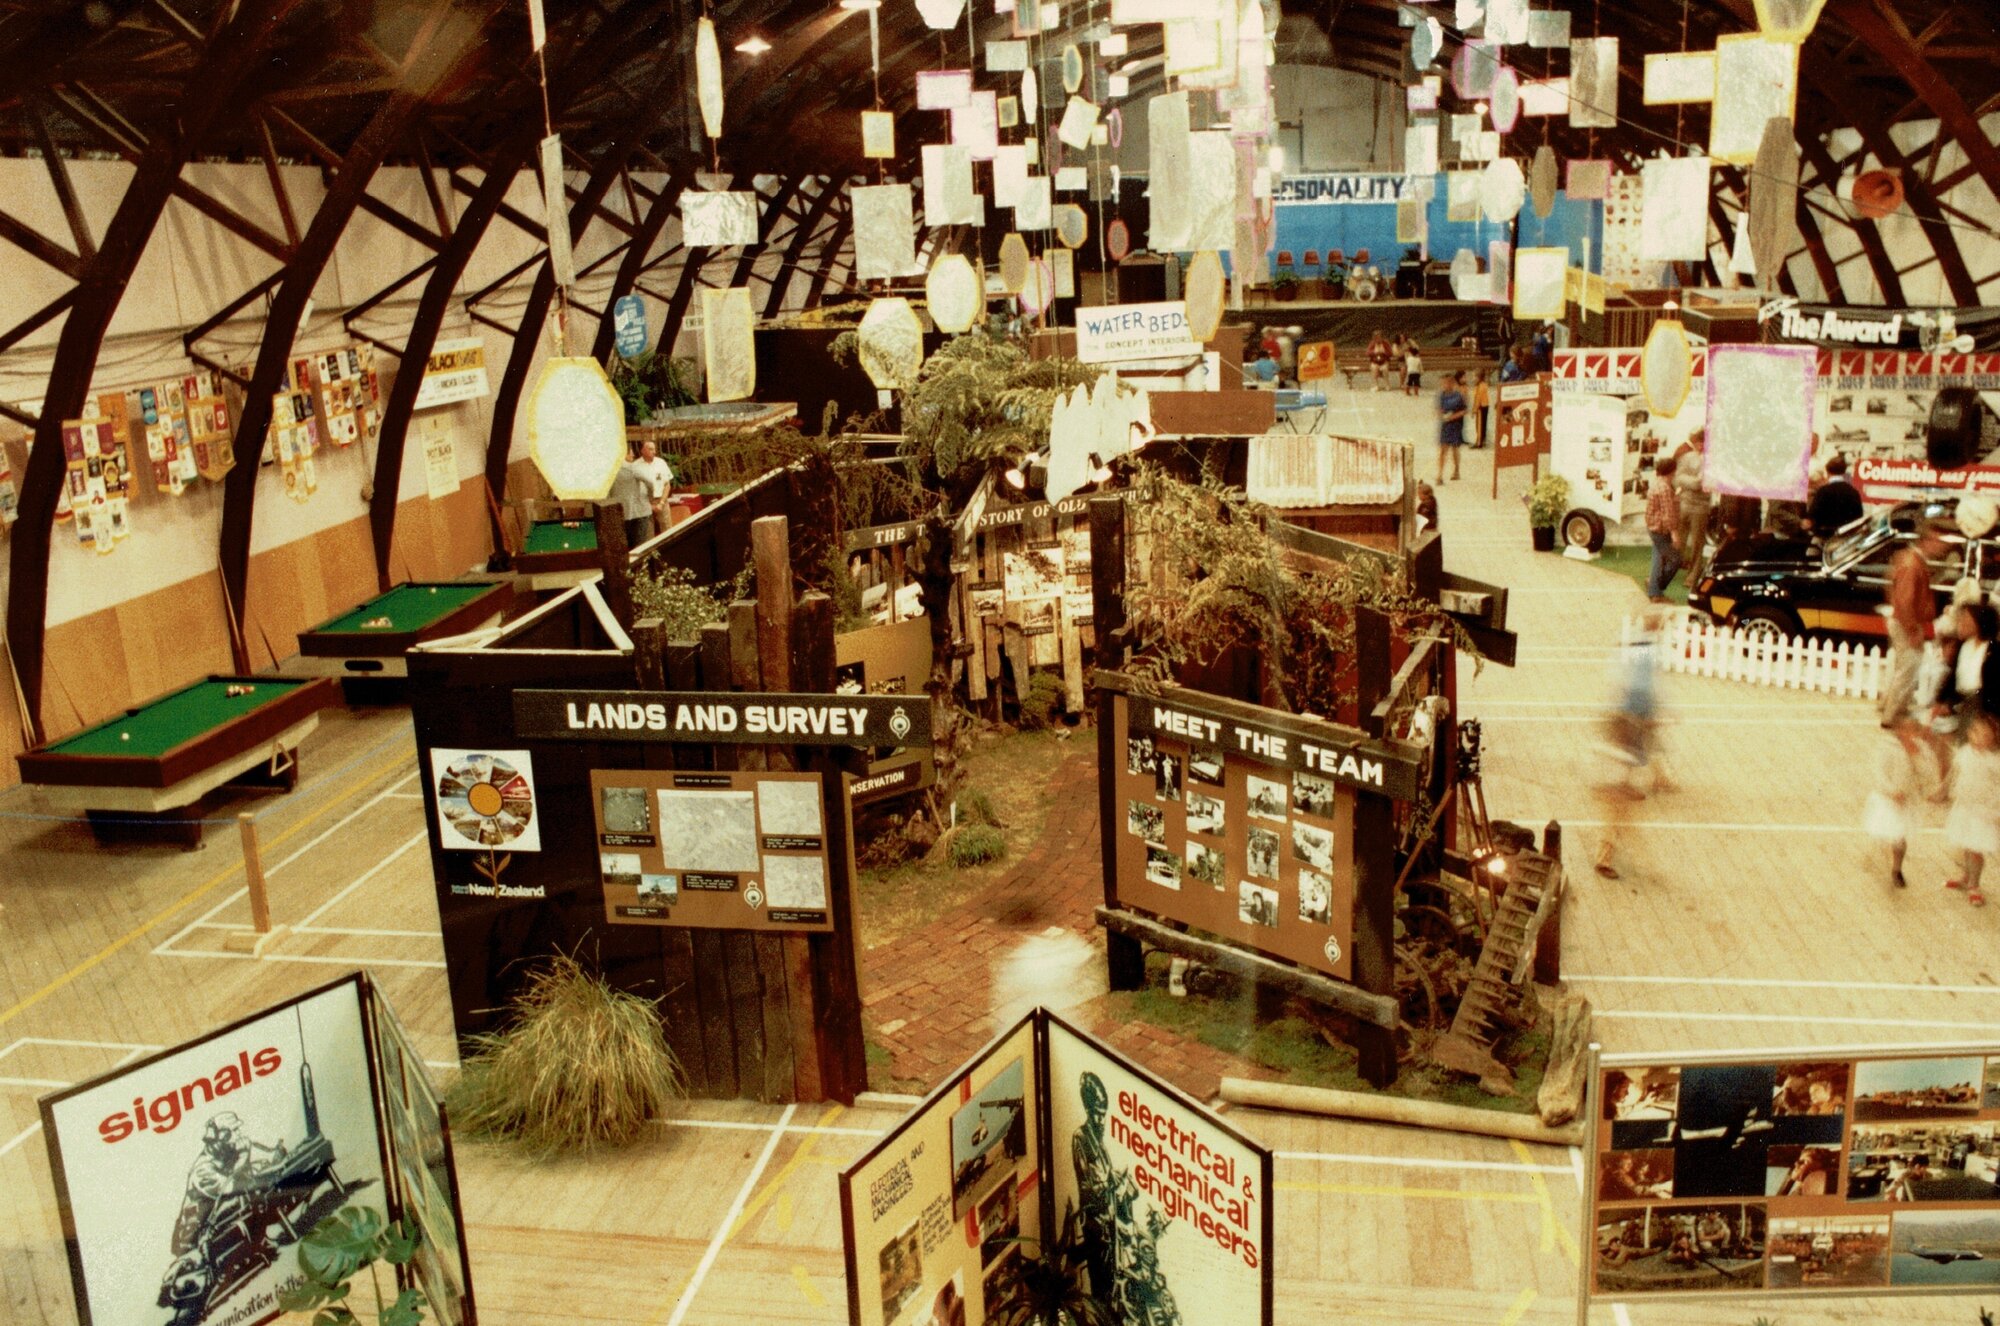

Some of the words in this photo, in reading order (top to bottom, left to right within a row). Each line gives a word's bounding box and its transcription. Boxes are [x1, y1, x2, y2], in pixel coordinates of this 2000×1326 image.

[1271, 177, 1405, 200] RSONALITY
[1086, 312, 1145, 335] WATER
[1781, 308, 1820, 339] The
[1821, 310, 1902, 344] Award
[1105, 339, 1143, 349] CONCEPT
[1858, 460, 1938, 484] Columbia
[874, 527, 906, 544] THE
[980, 507, 1024, 527] STORY
[566, 703, 667, 730] LANDS
[675, 704, 738, 732] AND
[745, 706, 868, 735] SURVEY
[1154, 707, 1221, 742] MEET
[1235, 727, 1287, 760] THE
[1301, 743, 1383, 786] TEAM
[850, 770, 905, 795] NSERVATION
[468, 883, 495, 896] New
[498, 884, 545, 897] Zealand
[98, 1047, 282, 1143] signals
[910, 1141, 925, 1161] AND
[1118, 1091, 1235, 1187] electrical
[1242, 1175, 1255, 1202] &
[1111, 1115, 1249, 1231] mechanical
[1134, 1165, 1258, 1269] engineers
